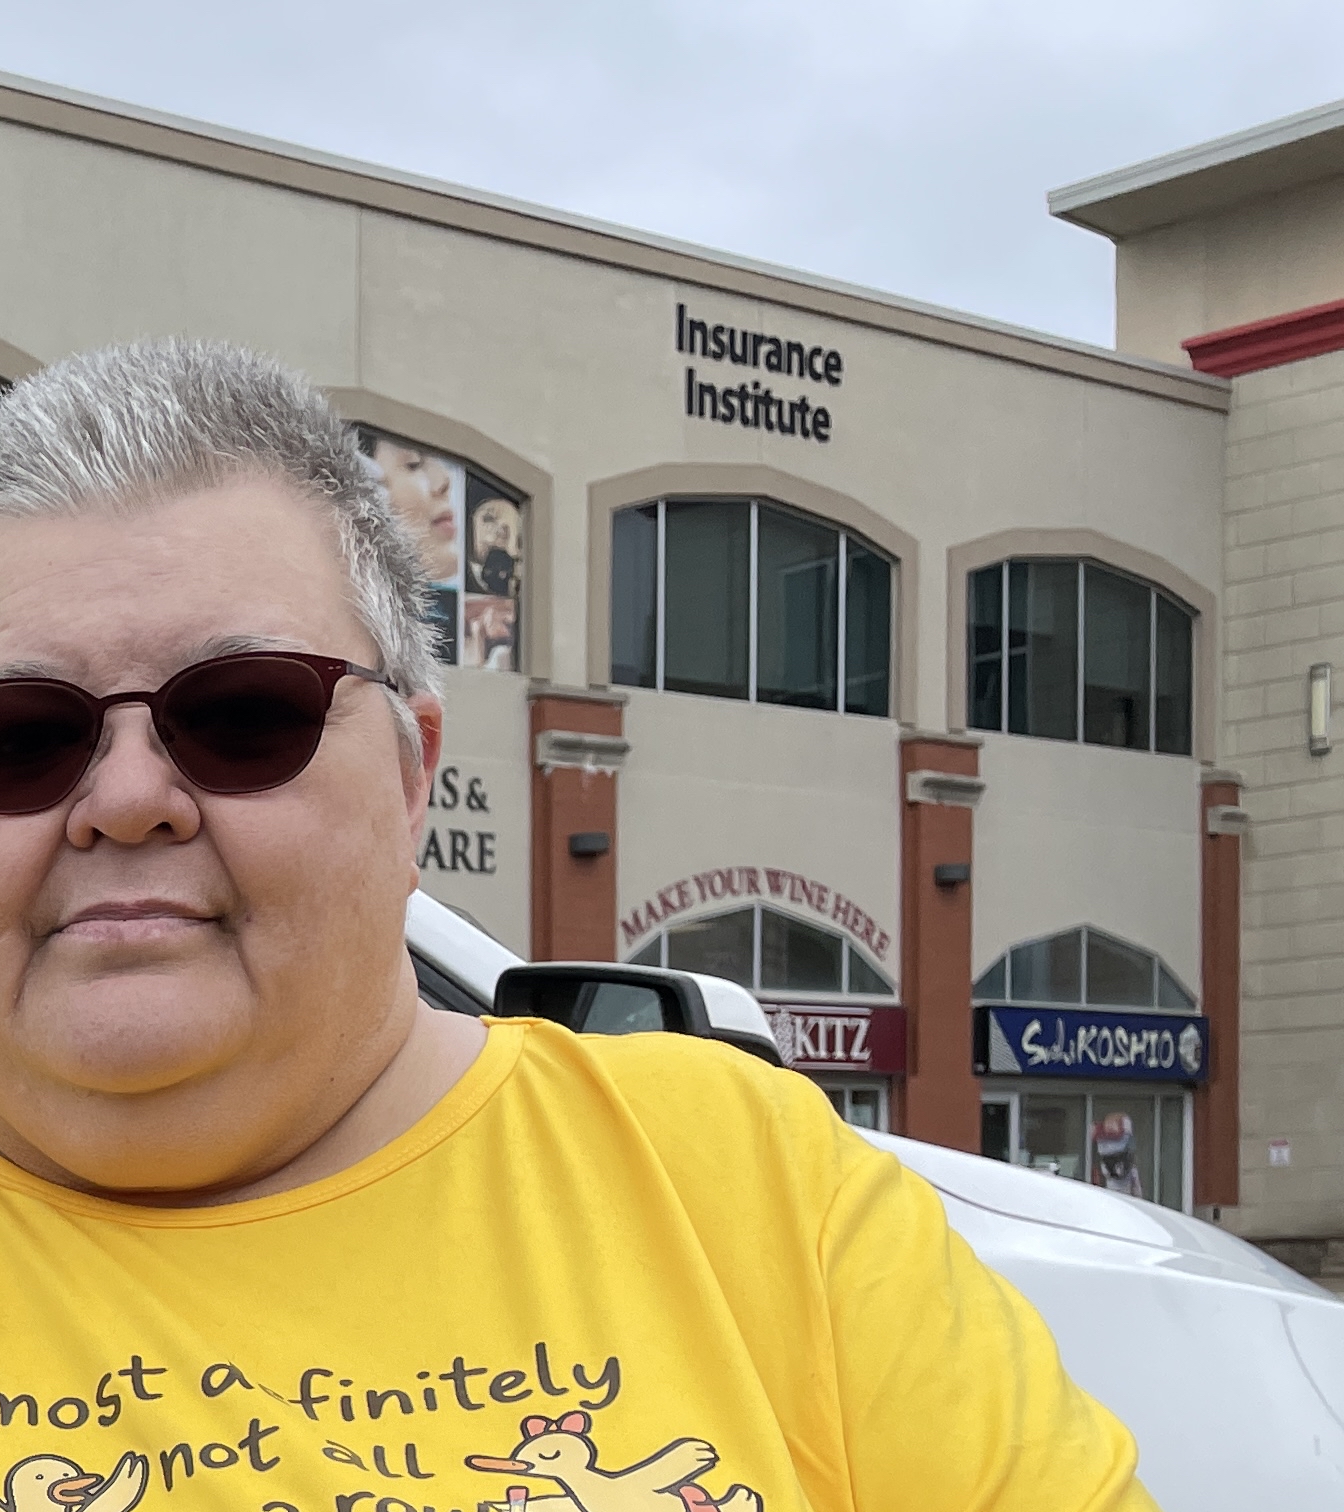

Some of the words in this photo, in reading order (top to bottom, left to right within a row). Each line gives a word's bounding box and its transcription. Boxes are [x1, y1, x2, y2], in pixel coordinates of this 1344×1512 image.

[676, 302, 844, 386] Insurance
[686, 367, 831, 442] Institute
[417, 827, 498, 876] ARE
[620, 879, 695, 947] MAKE
[691, 866, 762, 902] YOUR
[763, 867, 831, 914] WINE
[830, 893, 892, 961] HERE
[793, 1015, 872, 1061] KITZ
[159, 1417, 281, 1493] not
